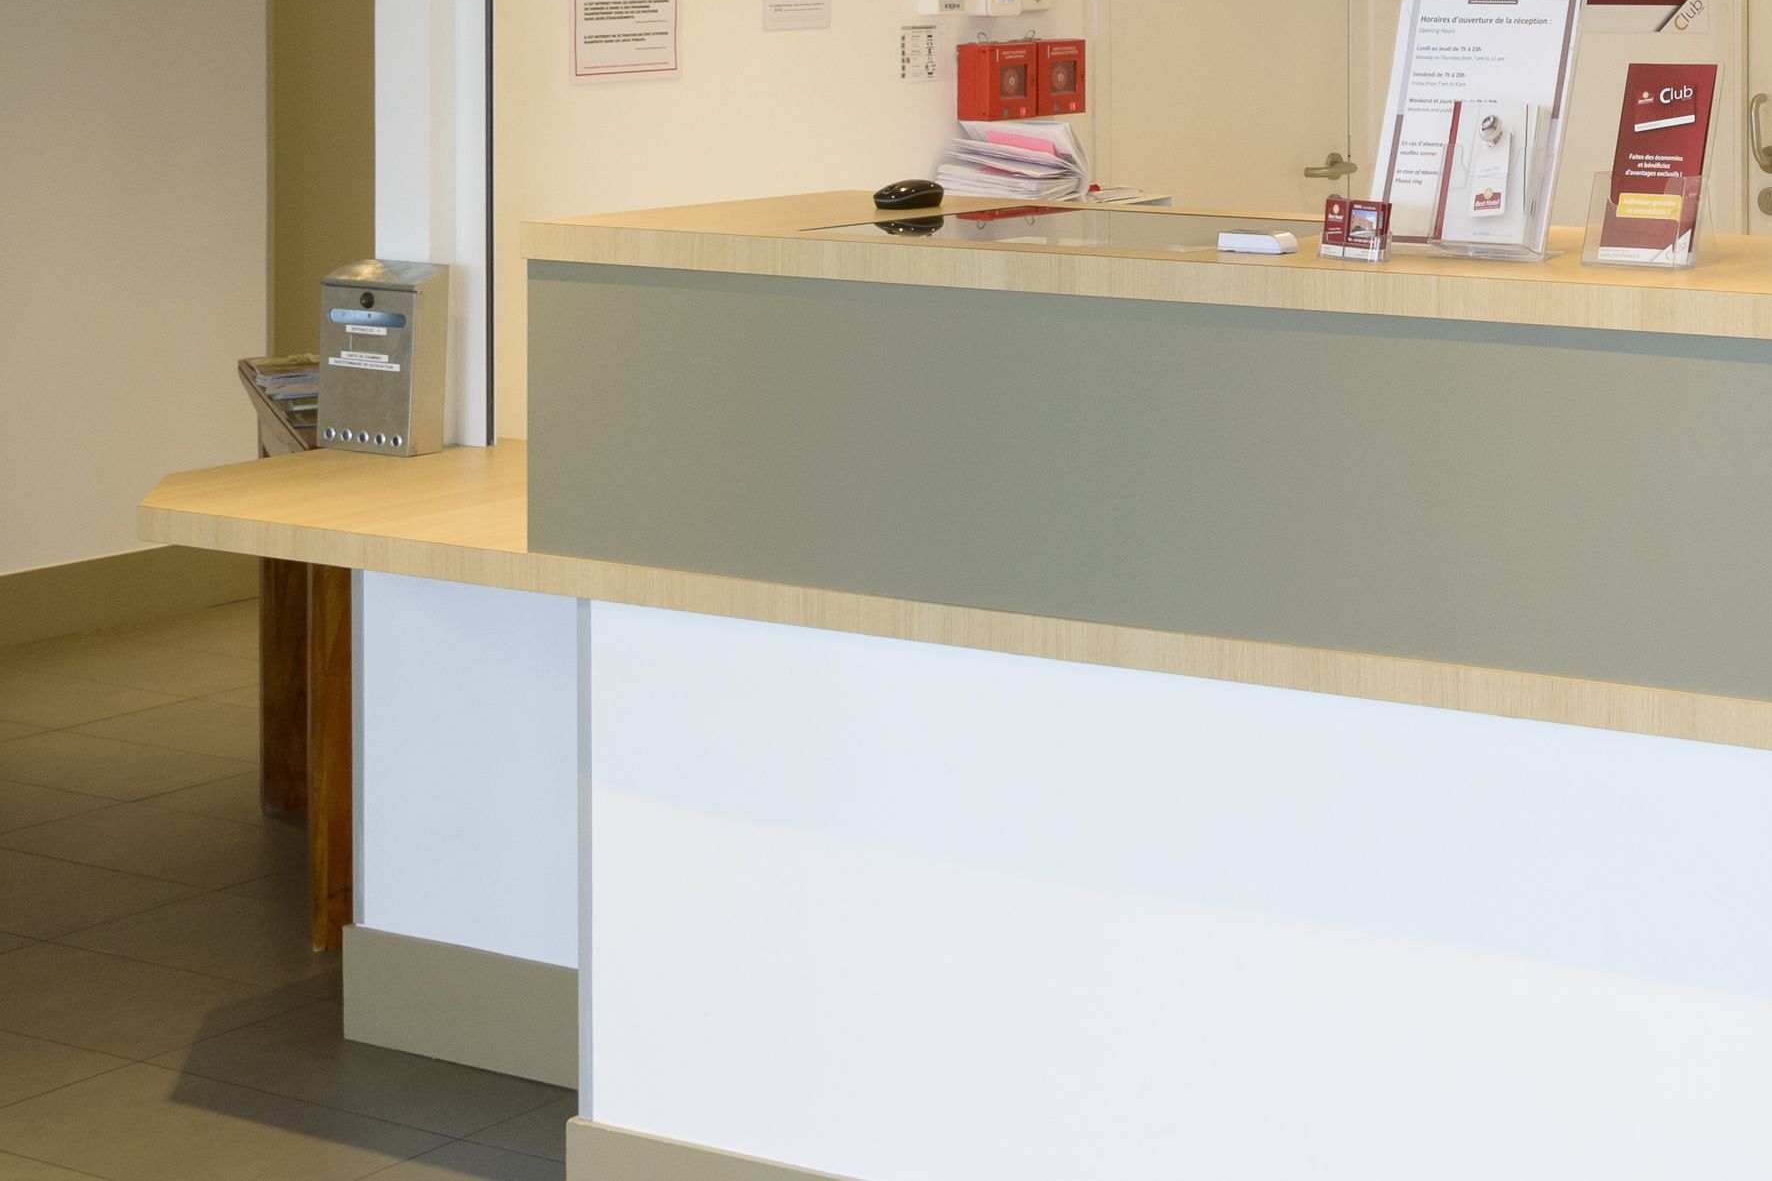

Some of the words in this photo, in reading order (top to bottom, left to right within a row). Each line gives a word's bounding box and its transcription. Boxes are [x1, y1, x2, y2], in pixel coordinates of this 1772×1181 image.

[1514, 17, 1547, 25] réception
[1675, 0, 1703, 31] Club
[1660, 86, 1693, 103] Club
